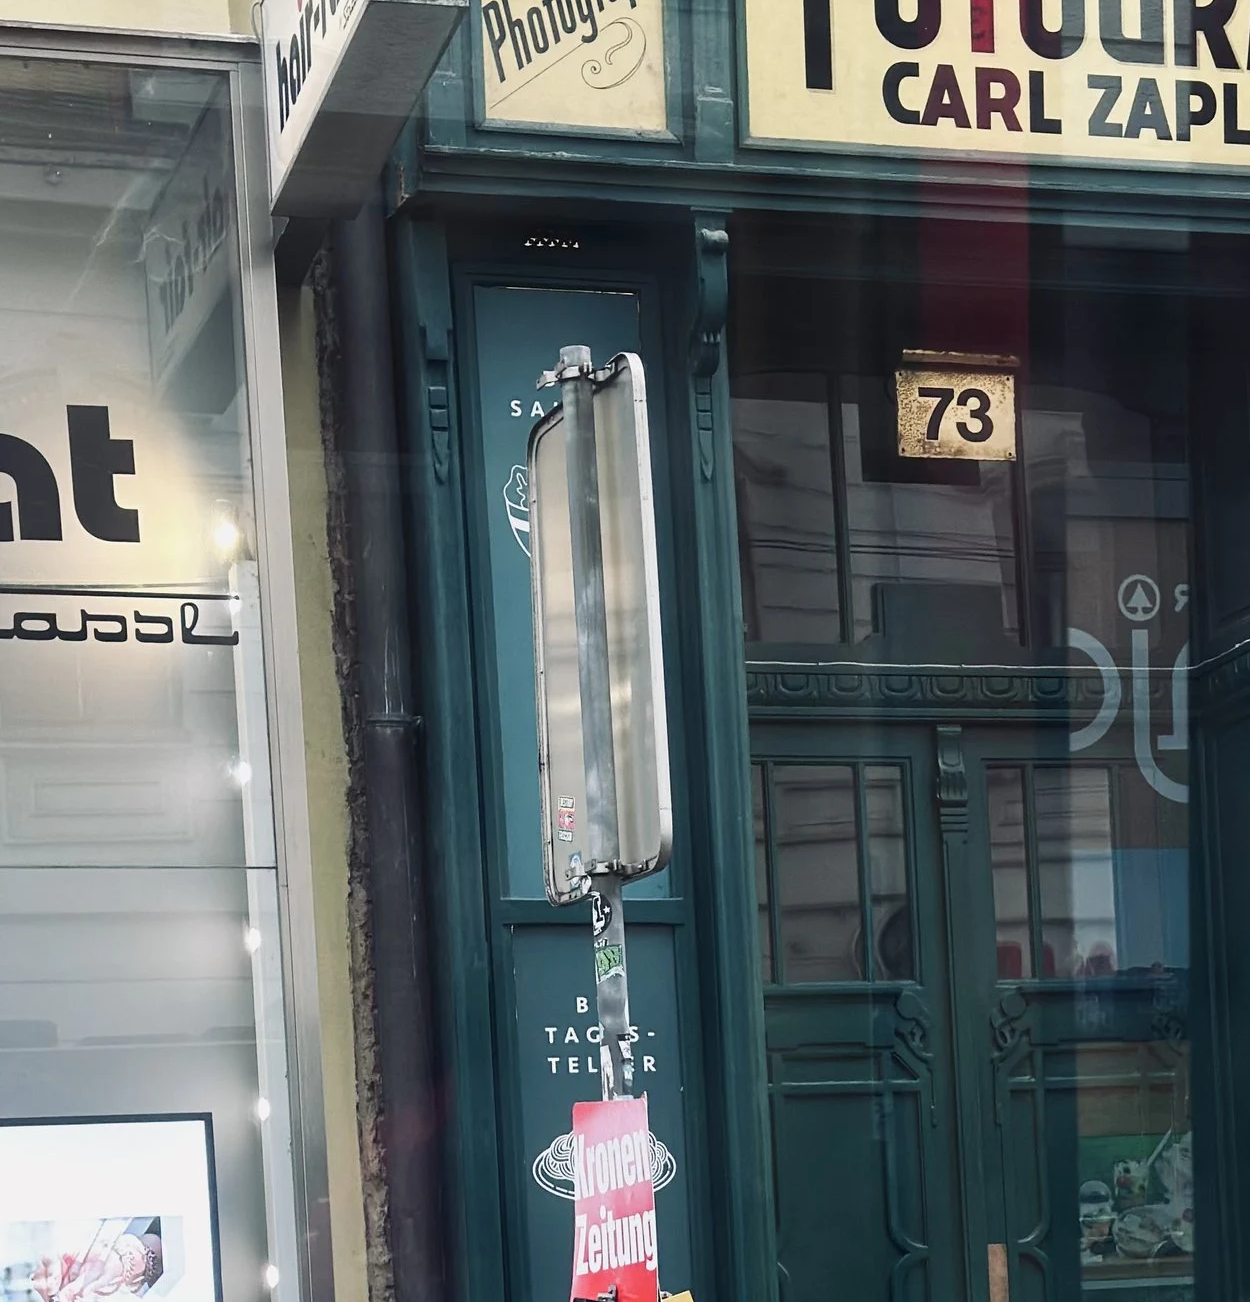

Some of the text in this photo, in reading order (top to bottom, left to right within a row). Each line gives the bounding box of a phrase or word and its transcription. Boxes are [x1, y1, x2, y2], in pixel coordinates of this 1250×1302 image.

[882, 62, 1062, 135] CARL
[918, 386, 994, 443] 73
[545, 1026, 655, 1043] TAGS-
[547, 1056, 656, 1073] TELR
[574, 1129, 650, 1200] Kronen
[575, 1205, 658, 1277] Zeitung
